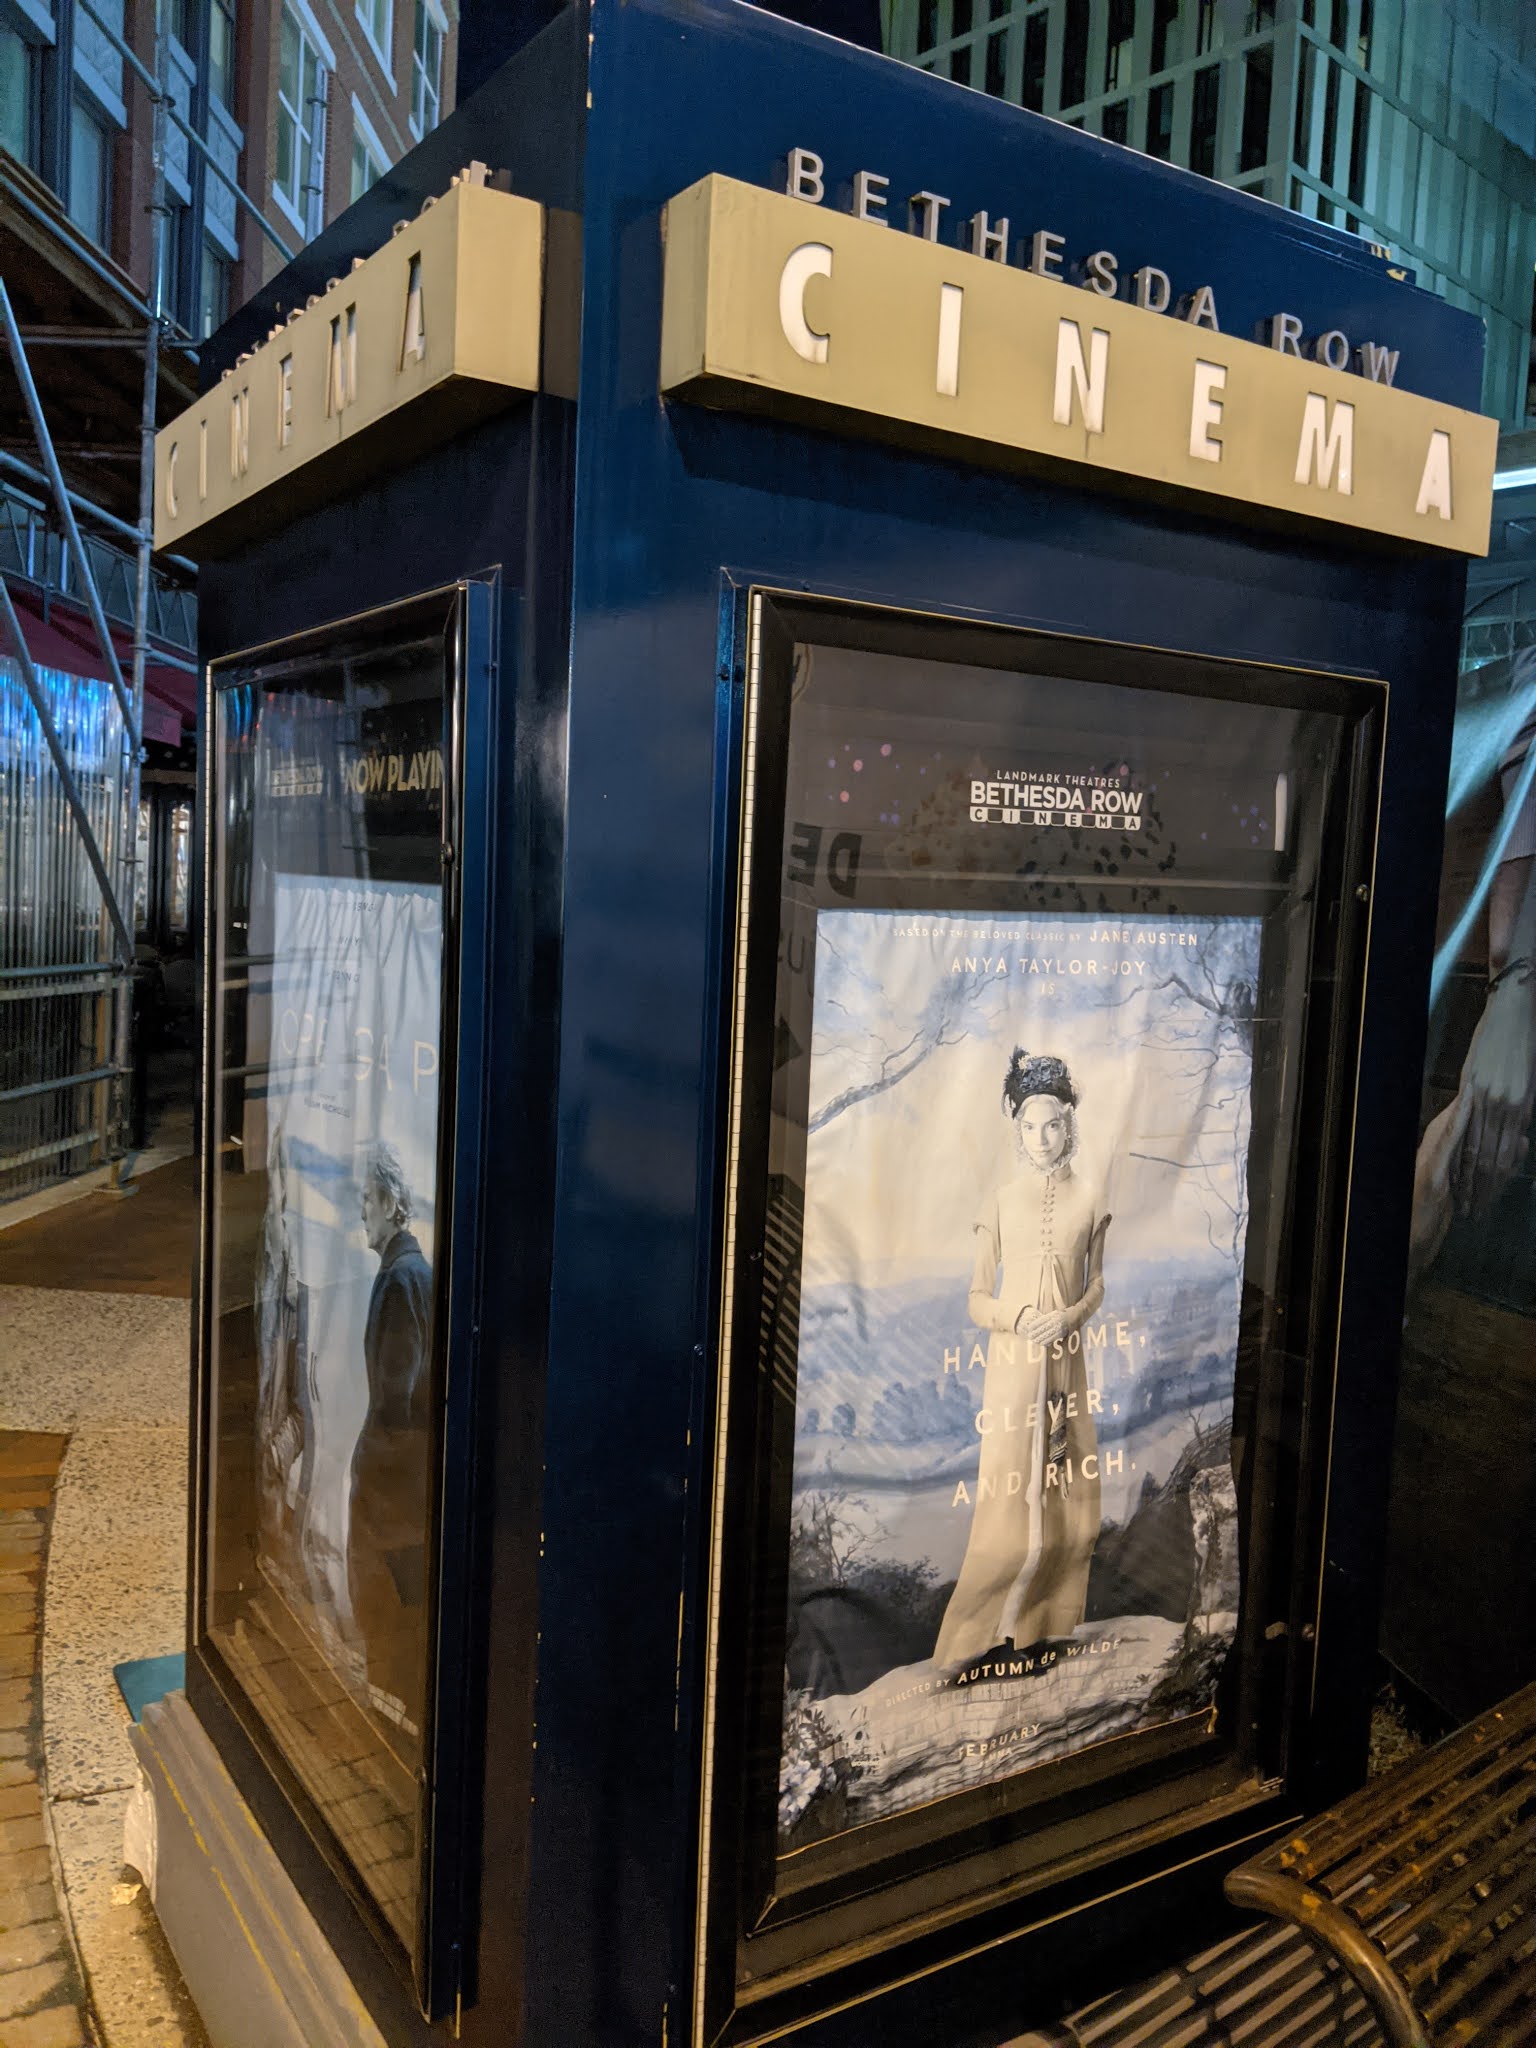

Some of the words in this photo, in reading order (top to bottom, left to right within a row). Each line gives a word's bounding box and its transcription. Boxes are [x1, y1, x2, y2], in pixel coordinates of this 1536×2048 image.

[787, 147, 1221, 333] BETHESDA
[1272, 312, 1400, 388] ROW
[166, 249, 426, 518] CINEMA
[779, 241, 1453, 521] CINEMA
[345, 756, 386, 794] NOW
[996, 769, 1060, 784] LANDMARK
[1065, 774, 1120, 789] THEATRES
[970, 780, 1085, 811] BETHESDA
[1091, 789, 1143, 814] ROW
[970, 807, 1141, 830] CINEMA
[893, 928, 929, 938] BASED
[972, 929, 1021, 941] BELOVED
[1089, 929, 1130, 944] JANE
[1136, 931, 1198, 947] AUSTEN
[951, 956, 1008, 974] ANYA
[1019, 957, 1147, 977] TAYLOR-JOY
[1041, 982, 1056, 996] IS
[944, 1321, 1146, 1374] HANDSOME,
[975, 1389, 1120, 1435] CLEVER,
[951, 1471, 1022, 1508] AND
[1046, 1449, 1137, 1489] RICH.
[936, 1678, 951, 1688] BY
[957, 1657, 1034, 1685] AUTUMN
[1040, 1651, 1057, 1665] de
[1066, 1638, 1122, 1657] WILDE
[958, 1723, 1041, 1759] FEBRUARY
